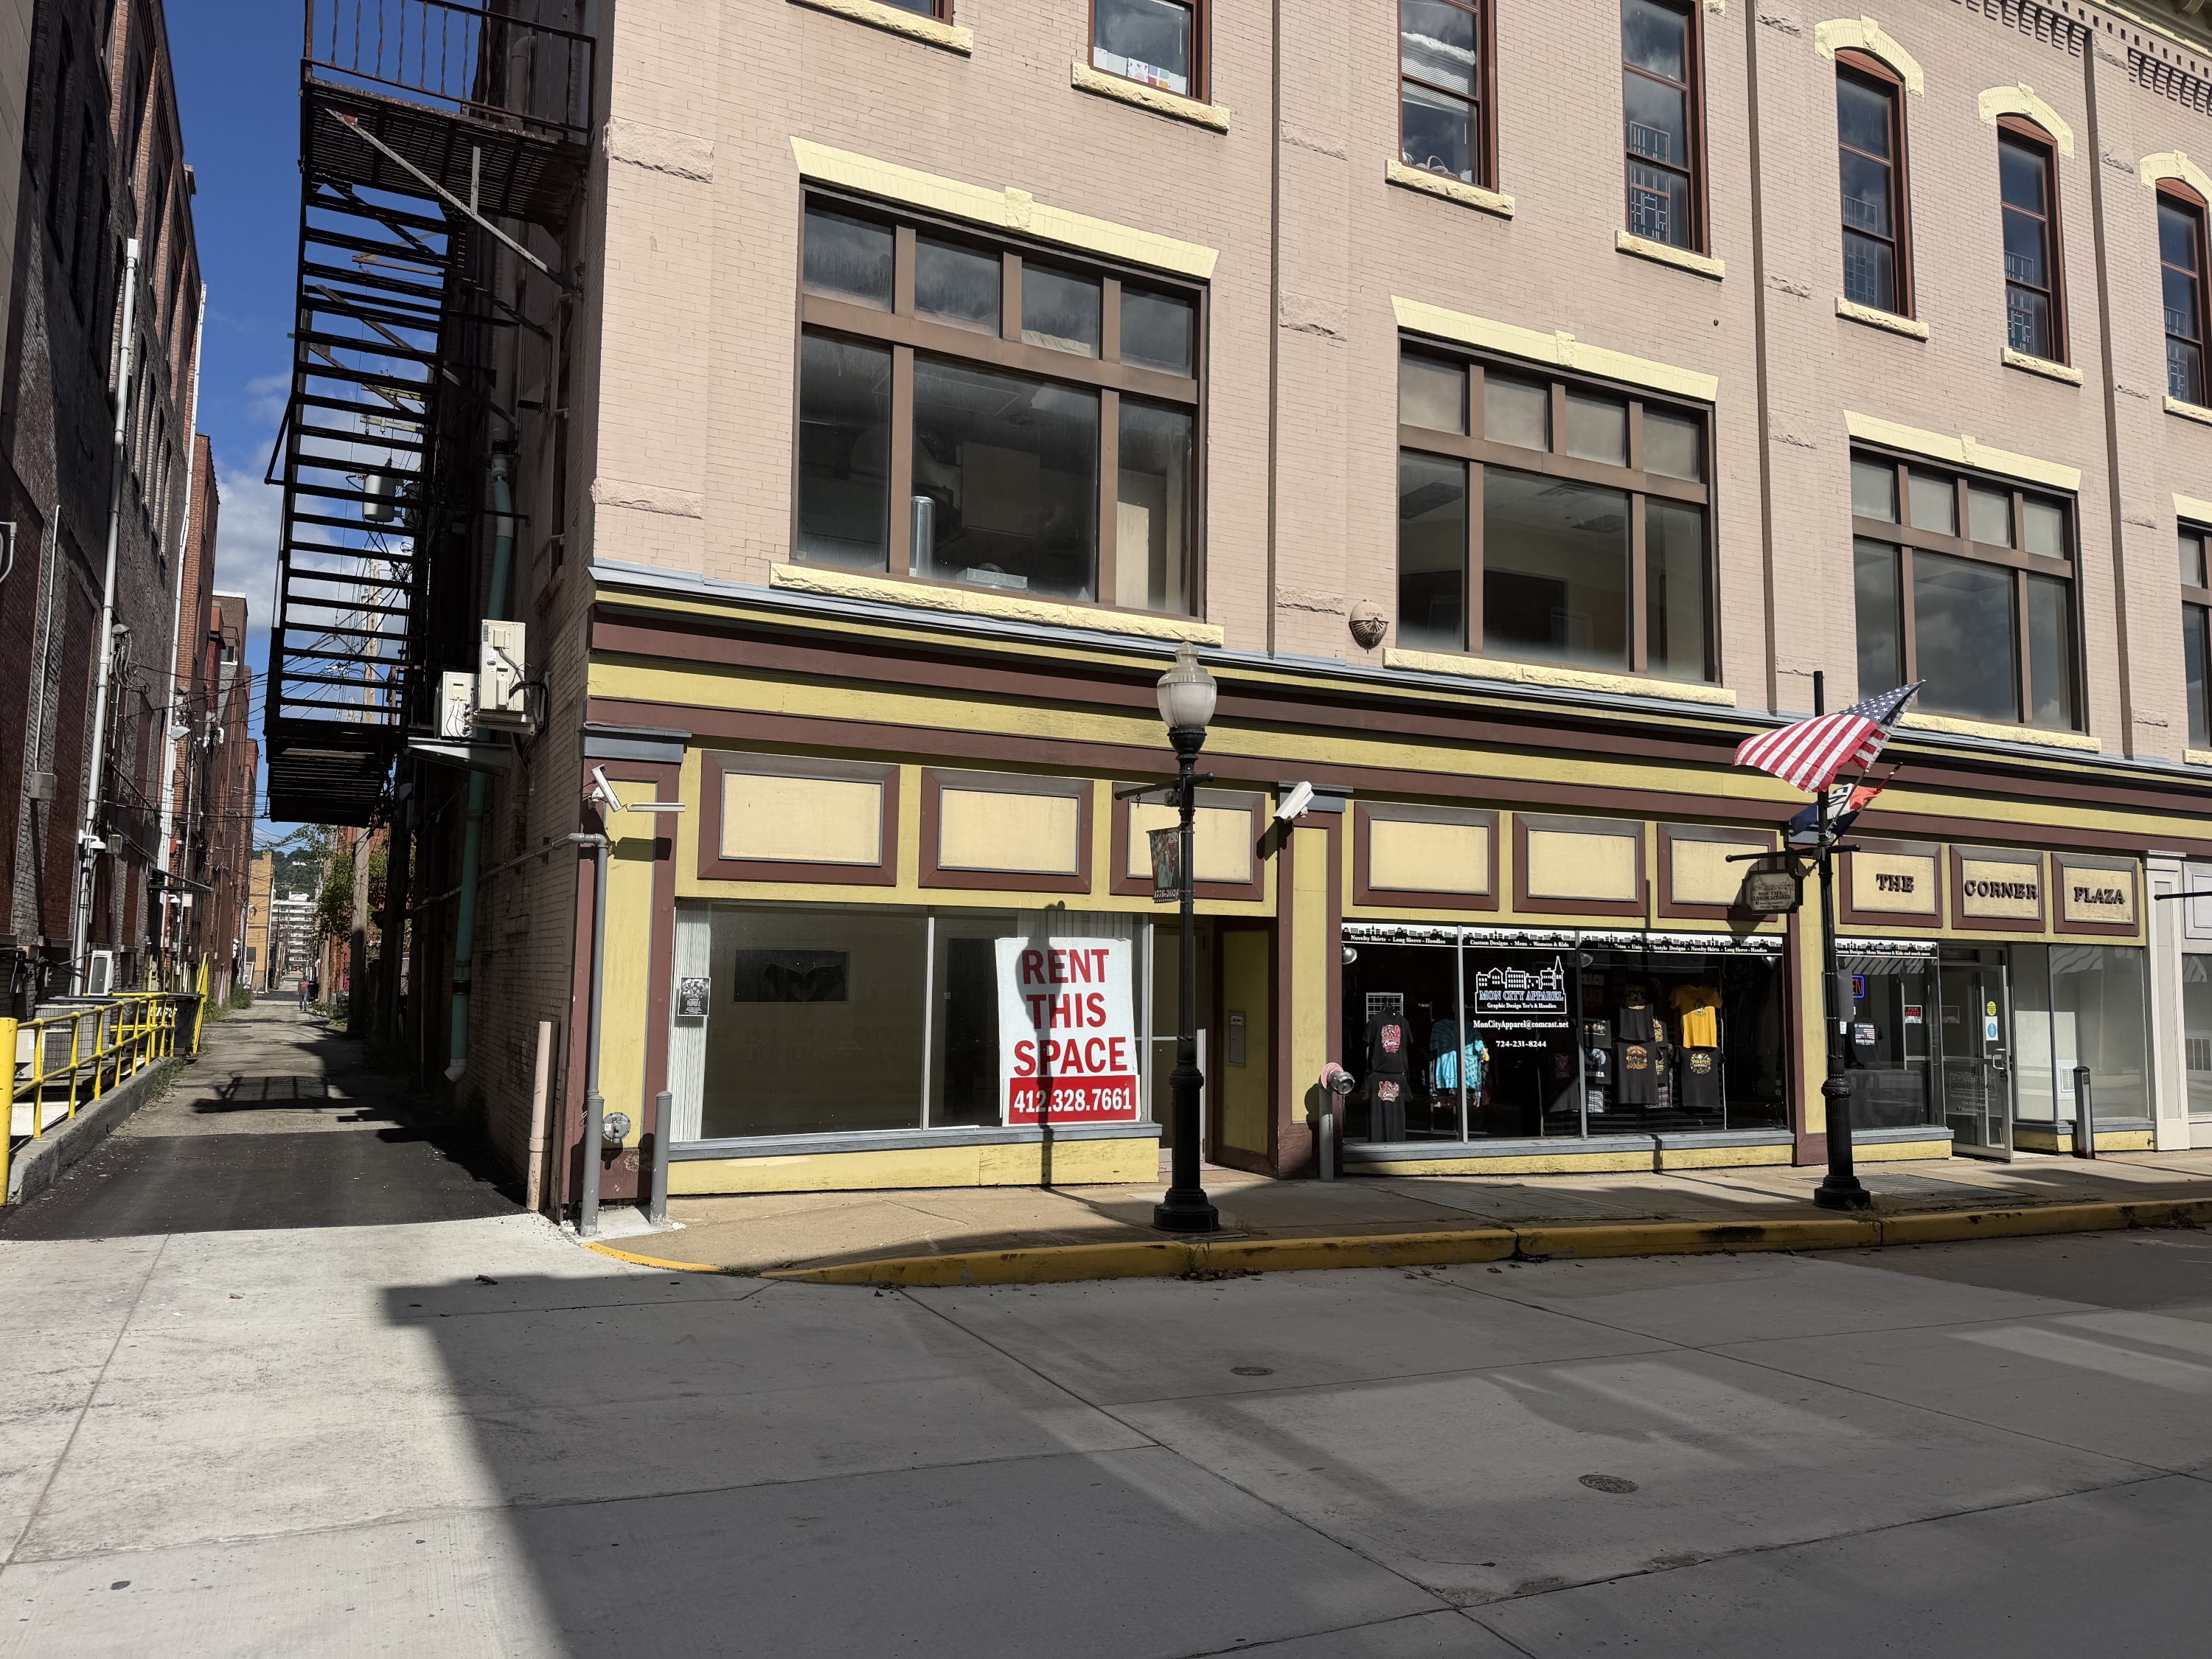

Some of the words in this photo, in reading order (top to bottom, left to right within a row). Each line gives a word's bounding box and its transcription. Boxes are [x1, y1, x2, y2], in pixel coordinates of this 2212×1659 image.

[1154, 888, 1180, 898] 1776-2026
[1876, 873, 1914, 893] THE
[1964, 879, 2039, 900] CORNER
[2073, 886, 2126, 905] PLAZA
[1351, 935, 1370, 943] Novelty
[1022, 949, 1110, 984] RENT
[1479, 990, 1502, 1001] MON
[1503, 990, 1525, 1001] CITY
[1526, 990, 1564, 1001] APPAREL
[1026, 992, 1107, 1029] THIS
[1473, 1020, 1569, 1030] MonCityApparel@comcast.net
[1014, 1037, 1128, 1077] SPACE
[1014, 1088, 1132, 1113] 412.328.7661
